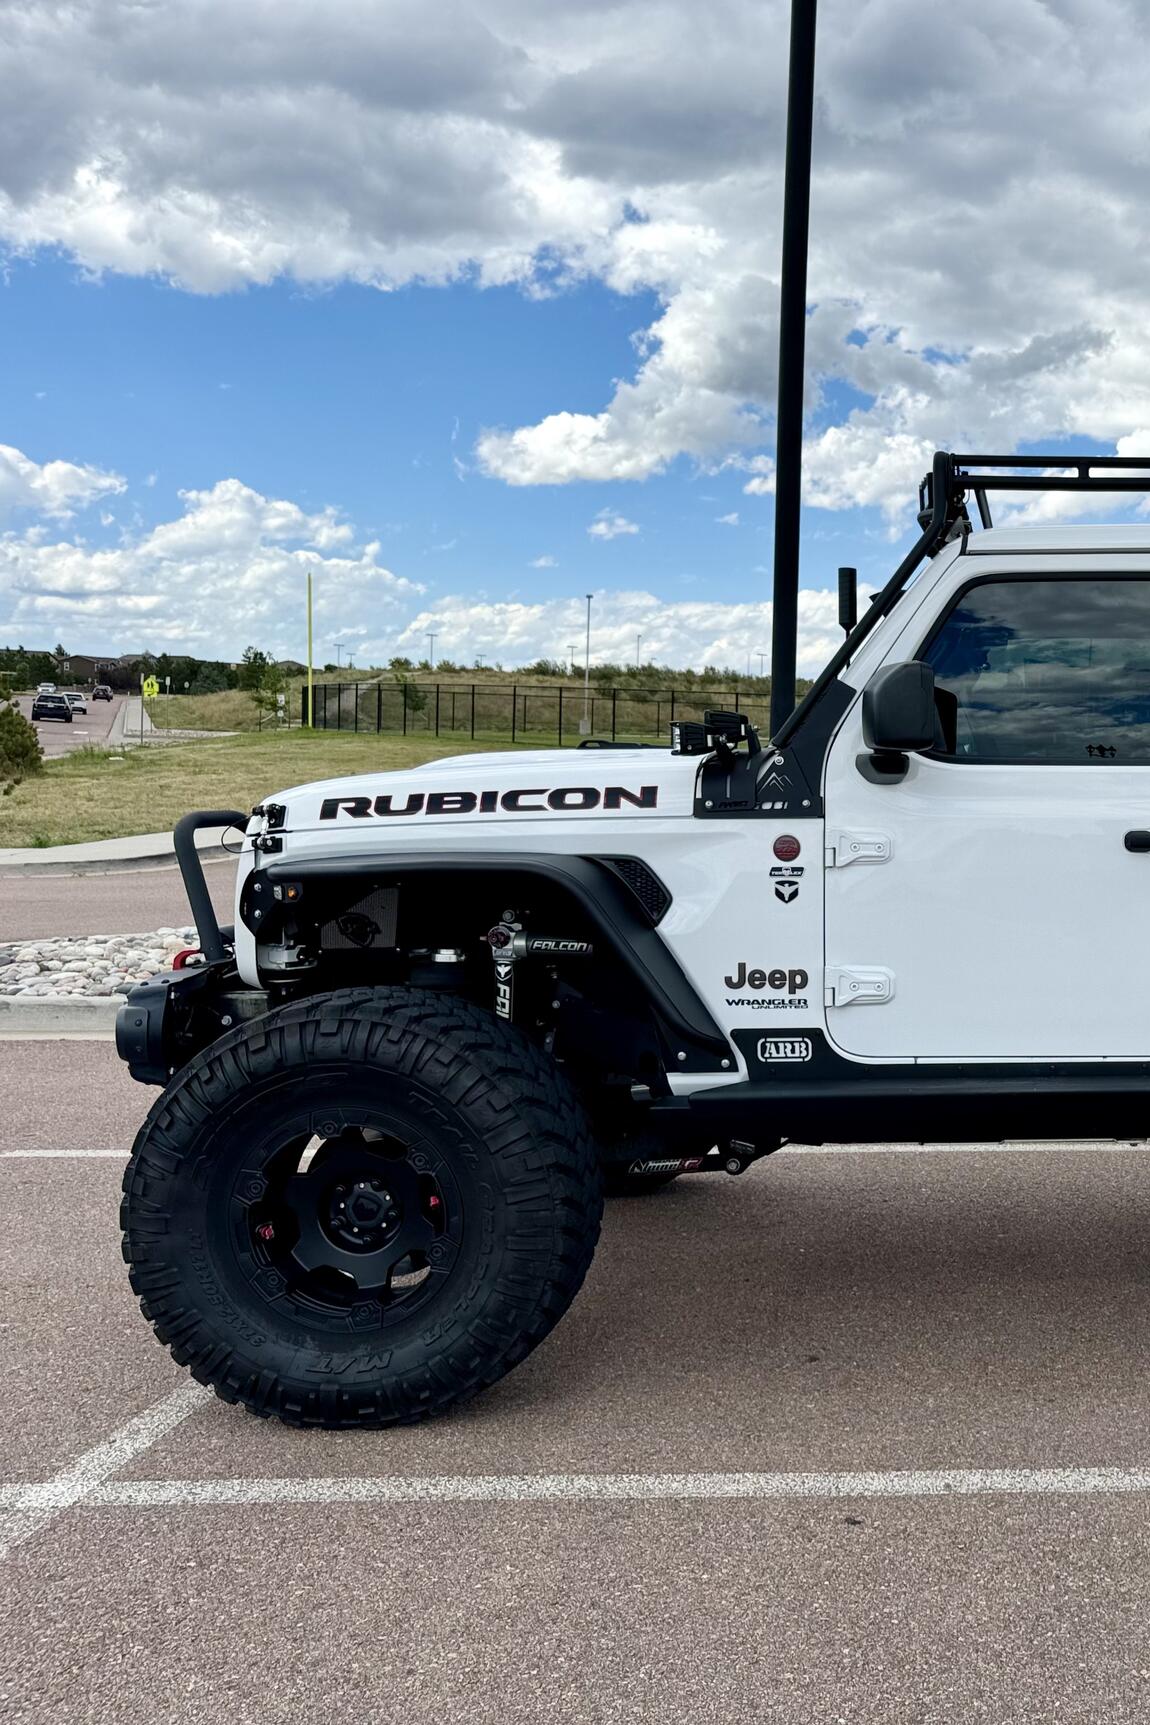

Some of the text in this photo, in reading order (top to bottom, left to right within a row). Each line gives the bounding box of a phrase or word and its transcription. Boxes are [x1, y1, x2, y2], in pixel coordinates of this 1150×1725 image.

[319, 785, 659, 821] RUBICON
[532, 940, 588, 951] FALCON
[724, 962, 809, 995] Jeep
[725, 998, 808, 1006] WRANGLER
[763, 1042, 808, 1058] ARB
